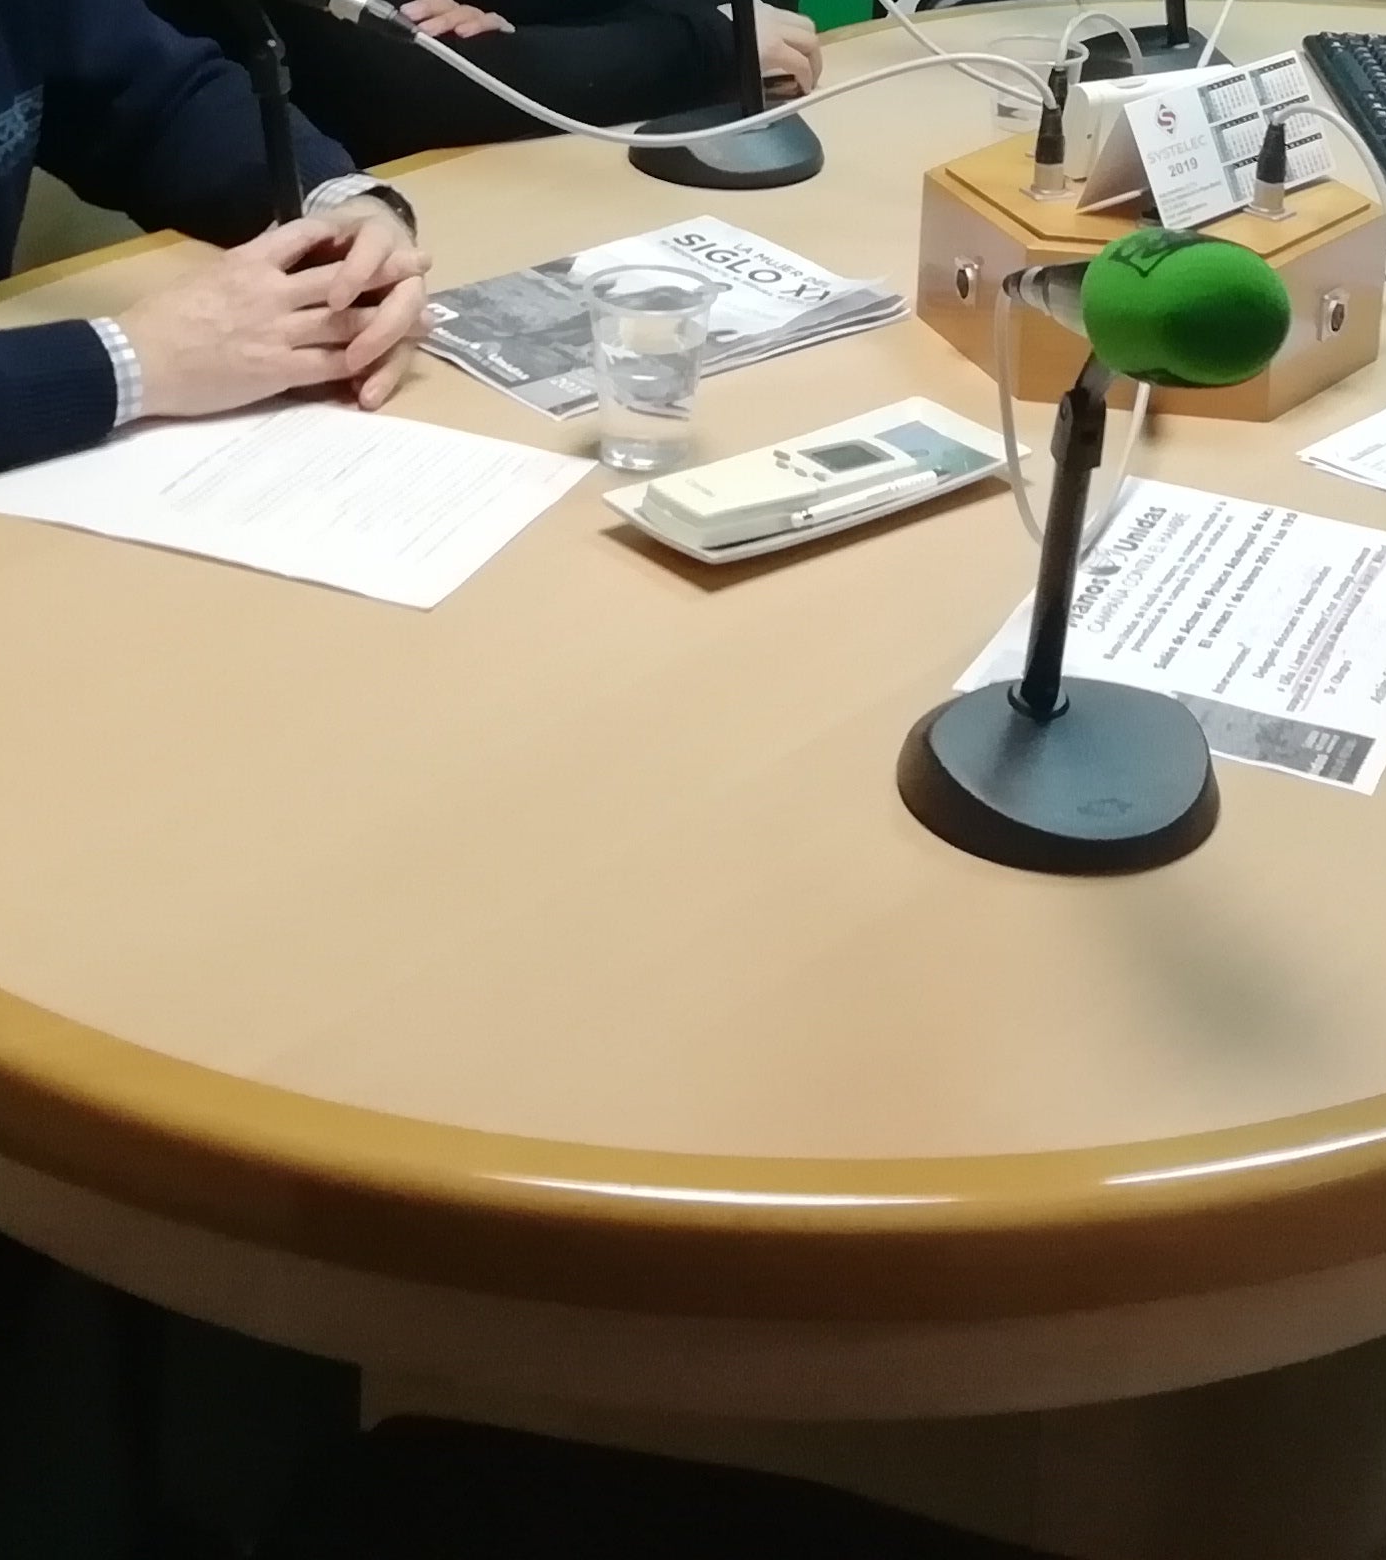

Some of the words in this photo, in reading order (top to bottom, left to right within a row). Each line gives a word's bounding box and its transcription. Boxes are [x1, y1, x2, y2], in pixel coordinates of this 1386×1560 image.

[1168, 157, 1199, 177] 2019
[673, 233, 782, 283] SIGLO
[734, 243, 753, 254] LA
[754, 253, 803, 277] MUJER
[1113, 506, 1167, 552] Unidas
